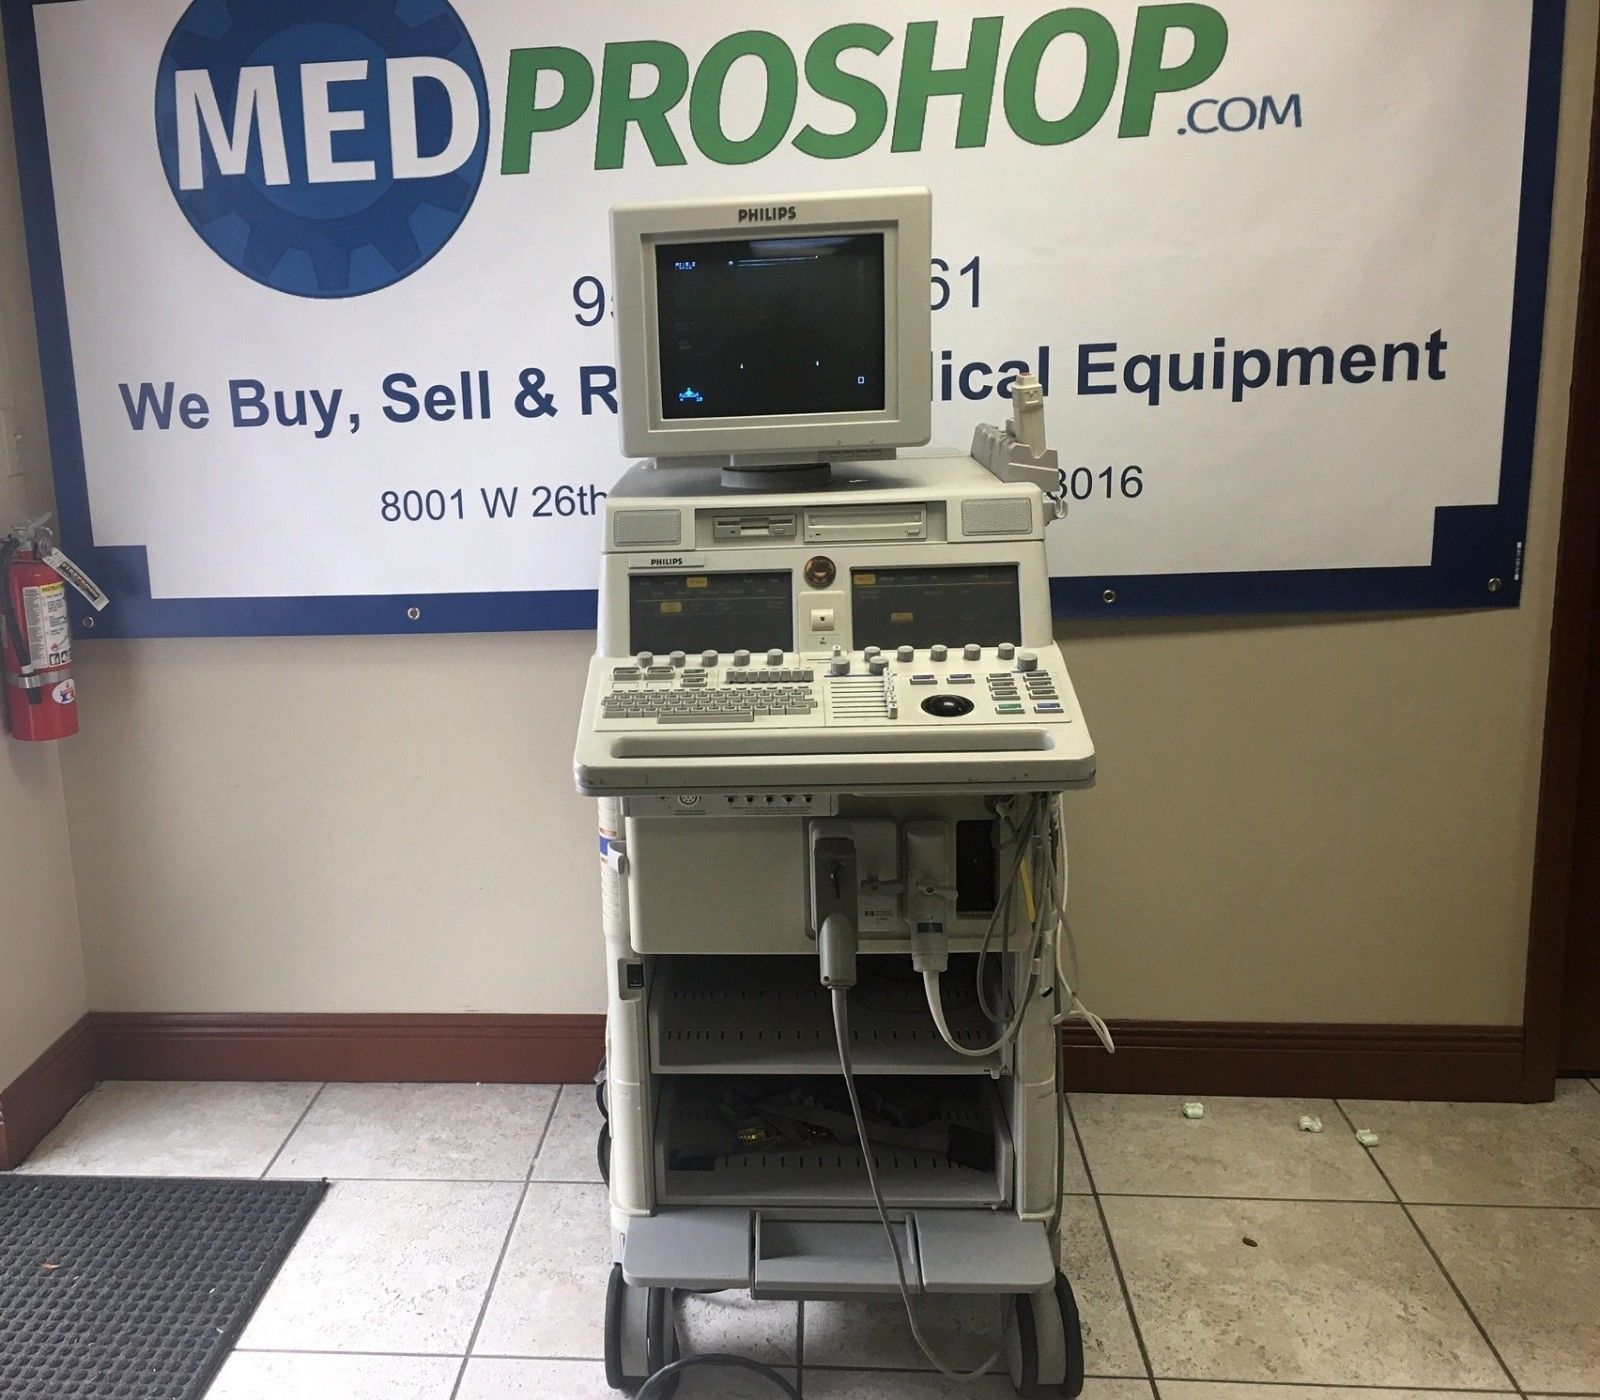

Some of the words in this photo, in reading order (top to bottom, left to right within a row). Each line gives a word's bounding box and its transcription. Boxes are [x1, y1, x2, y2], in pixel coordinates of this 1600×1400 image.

[737, 206, 797, 224] PHILIPS
[118, 381, 209, 430] We
[229, 377, 360, 439] Buy,
[383, 370, 491, 423] Sell
[515, 367, 557, 419] &
[1077, 328, 1448, 407] Equipment
[381, 488, 465, 522] 8001
[480, 486, 518, 519] W
[532, 484, 607, 517] 26th
[650, 558, 684, 567] PHILIPS
